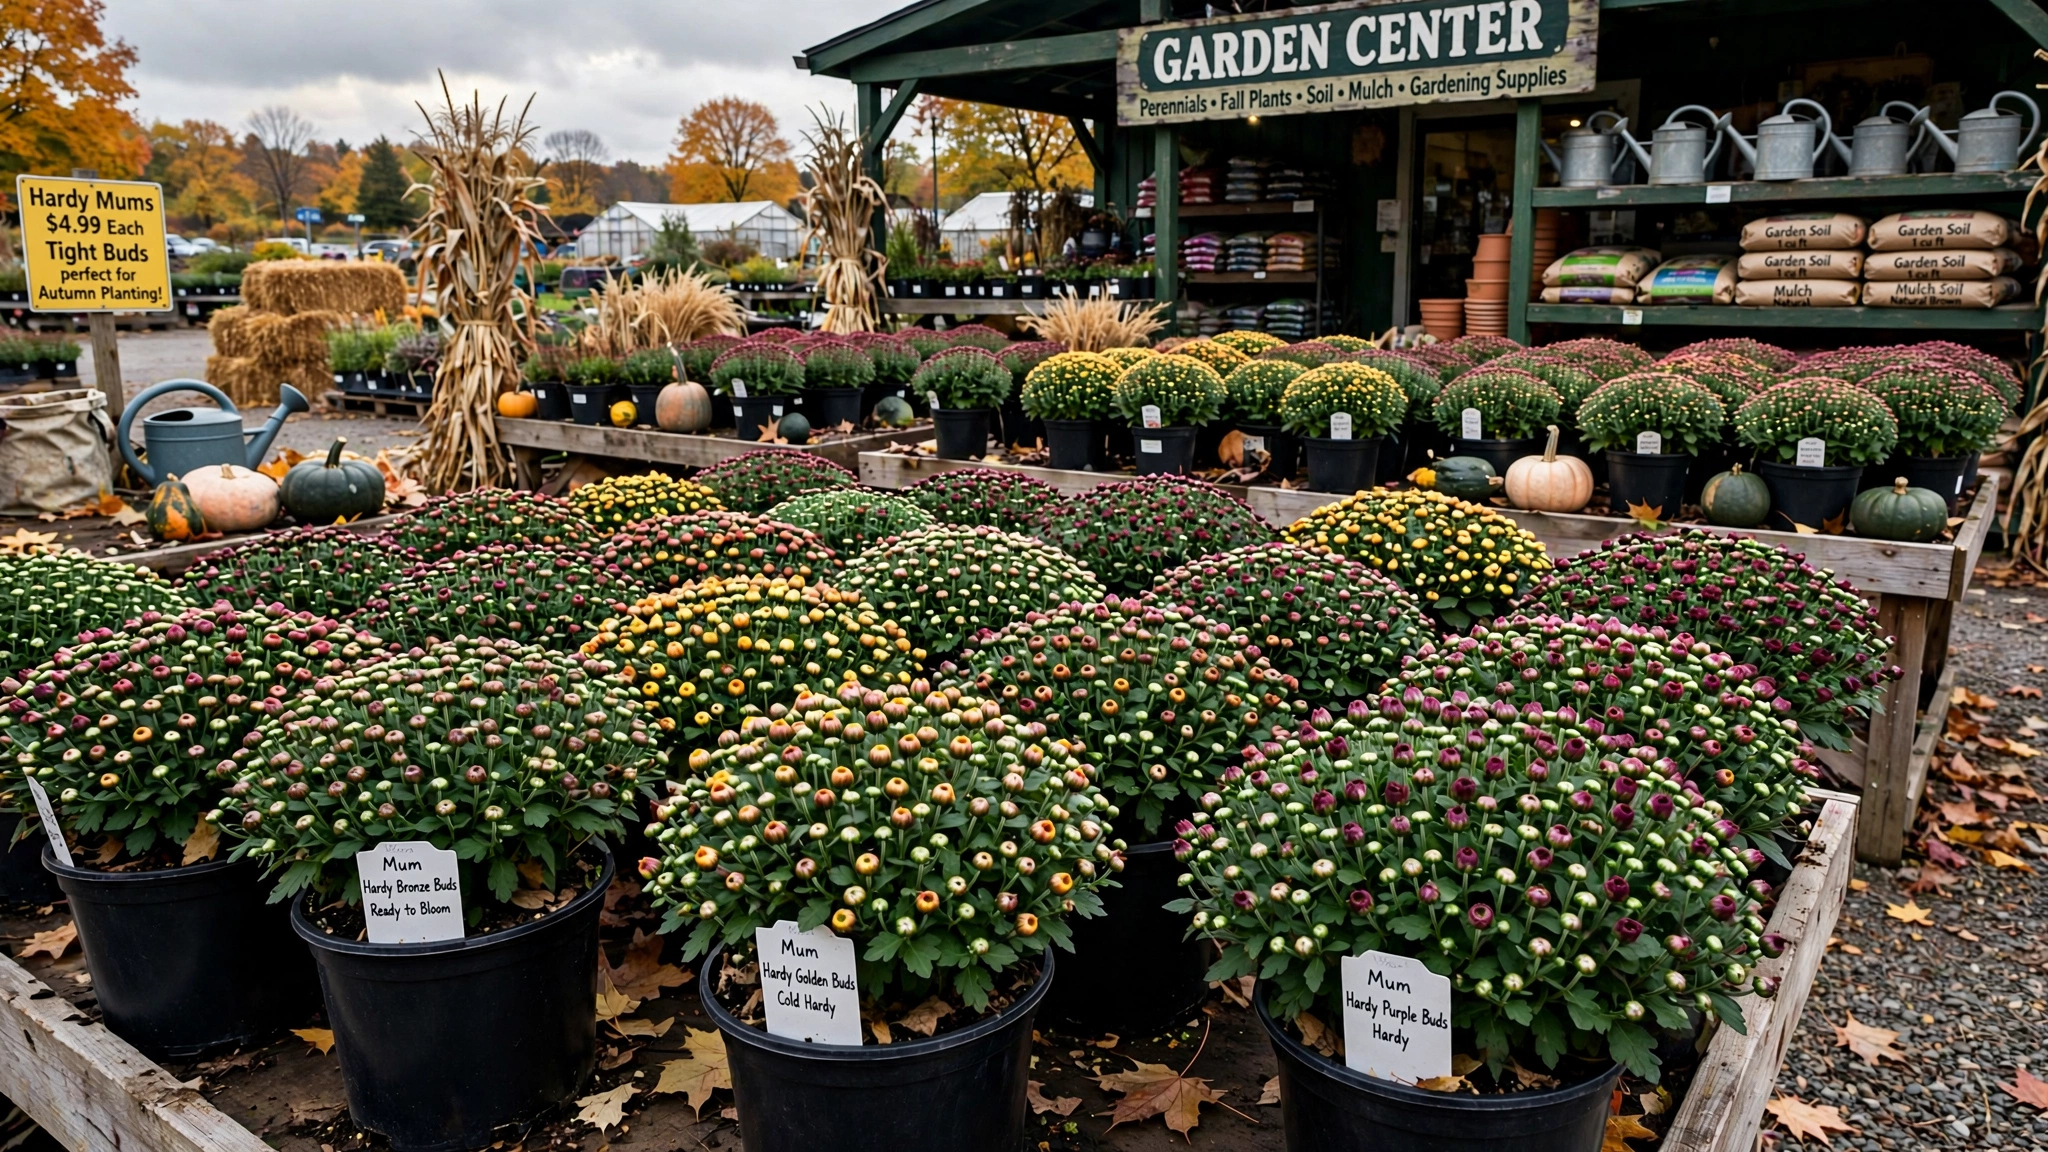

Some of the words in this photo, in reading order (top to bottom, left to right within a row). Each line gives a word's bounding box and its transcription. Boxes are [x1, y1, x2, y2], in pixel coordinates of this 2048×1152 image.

[1153, 21, 1332, 84] GARDEN
[1345, 0, 1544, 67] CENTER
[1140, 93, 1207, 117] Perennials
[1220, 90, 1245, 111] Fall
[1250, 89, 1292, 109] Plants
[1306, 84, 1334, 104] Soil
[1349, 78, 1393, 100] Mulch
[1410, 72, 1491, 96] Gardening
[1496, 65, 1567, 93] Supplies
[29, 187, 89, 213] Hardy
[96, 191, 154, 212] Mums
[46, 213, 101, 234] $4.99
[107, 220, 144, 236] Each
[1765, 225, 1806, 238] Garden
[1809, 224, 1832, 236] Soil
[1898, 224, 1942, 236] Garden
[1947, 223, 1971, 235] Soil
[1936, 237, 1945, 246] ft
[45, 241, 98, 265] Tight
[103, 243, 149, 262] Buds
[1764, 255, 1806, 267] Garden
[1809, 255, 1831, 266] Soil
[1894, 256, 1938, 268] Garden
[1942, 255, 1966, 268] Soil
[60, 267, 112, 284] perfect
[116, 267, 136, 281] for
[39, 285, 96, 300] Autumn
[101, 286, 162, 303] Planting!
[1774, 284, 1812, 297] Mulch
[1896, 283, 1935, 295] Mulch
[1939, 283, 1964, 295] Soil
[1890, 296, 1927, 305] Natural
[383, 856, 422, 871] Mum
[363, 879, 392, 899] Hardy
[396, 879, 430, 893] Bronze
[434, 877, 457, 892] Buds
[370, 902, 401, 922] Ready
[404, 904, 416, 915] to
[420, 901, 451, 915] Bloom
[781, 939, 819, 959] Mum
[762, 962, 792, 987] Hardy
[795, 968, 828, 987] Golden
[832, 972, 856, 990] Buds
[1367, 969, 1411, 994] Mum
[777, 990, 800, 1008] Cold
[804, 994, 836, 1020] Hardy
[1346, 990, 1378, 1019] Hardy
[1383, 1000, 1417, 1025] Purple
[1422, 1008, 1448, 1030] Buds
[1373, 1023, 1410, 1052] Hardy
